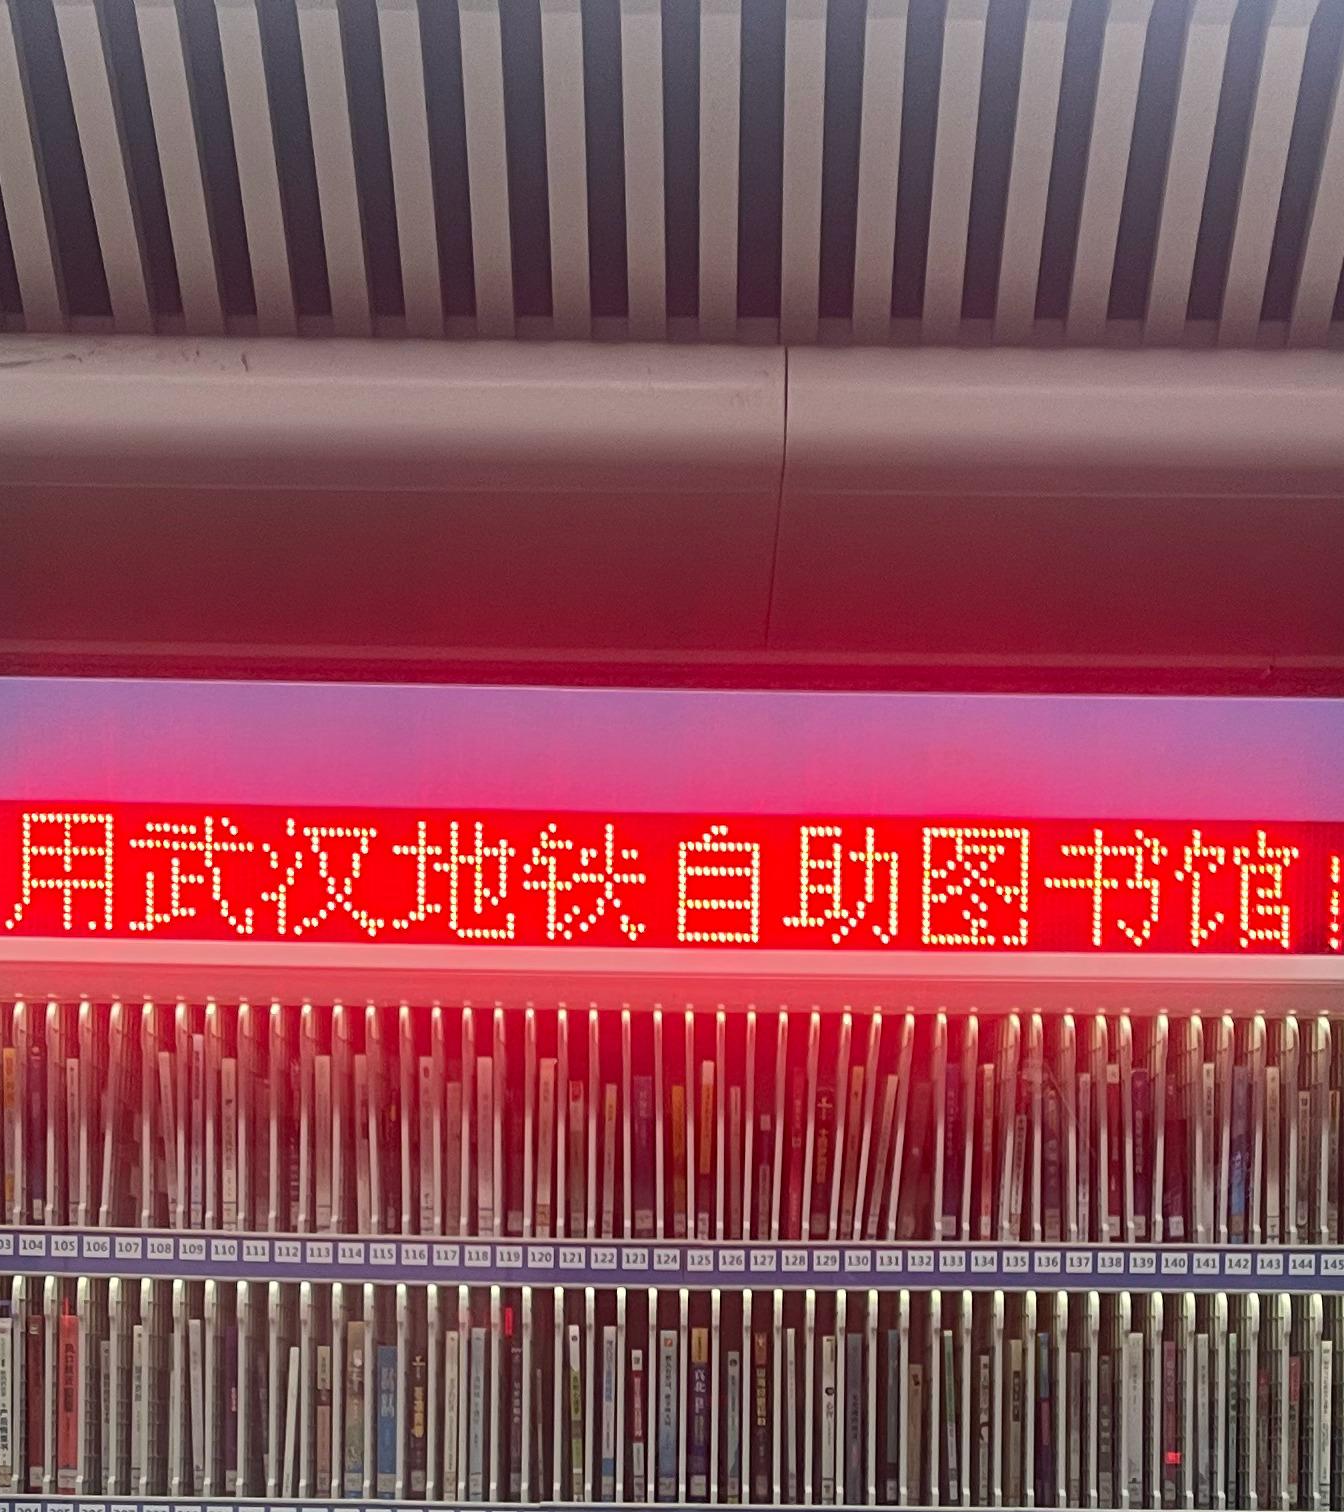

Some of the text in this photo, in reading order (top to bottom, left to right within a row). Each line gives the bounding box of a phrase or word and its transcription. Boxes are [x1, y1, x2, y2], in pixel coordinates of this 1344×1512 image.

[86, 1241, 108, 1252] 106
[246, 1246, 265, 1256] 111
[405, 1249, 426, 1260] 116
[563, 1252, 582, 1263] 121
[722, 1255, 742, 1265] 126
[880, 1256, 899, 1266] 131
[1038, 1256, 1058, 1267] 136
[1196, 1258, 1216, 1269] 141
